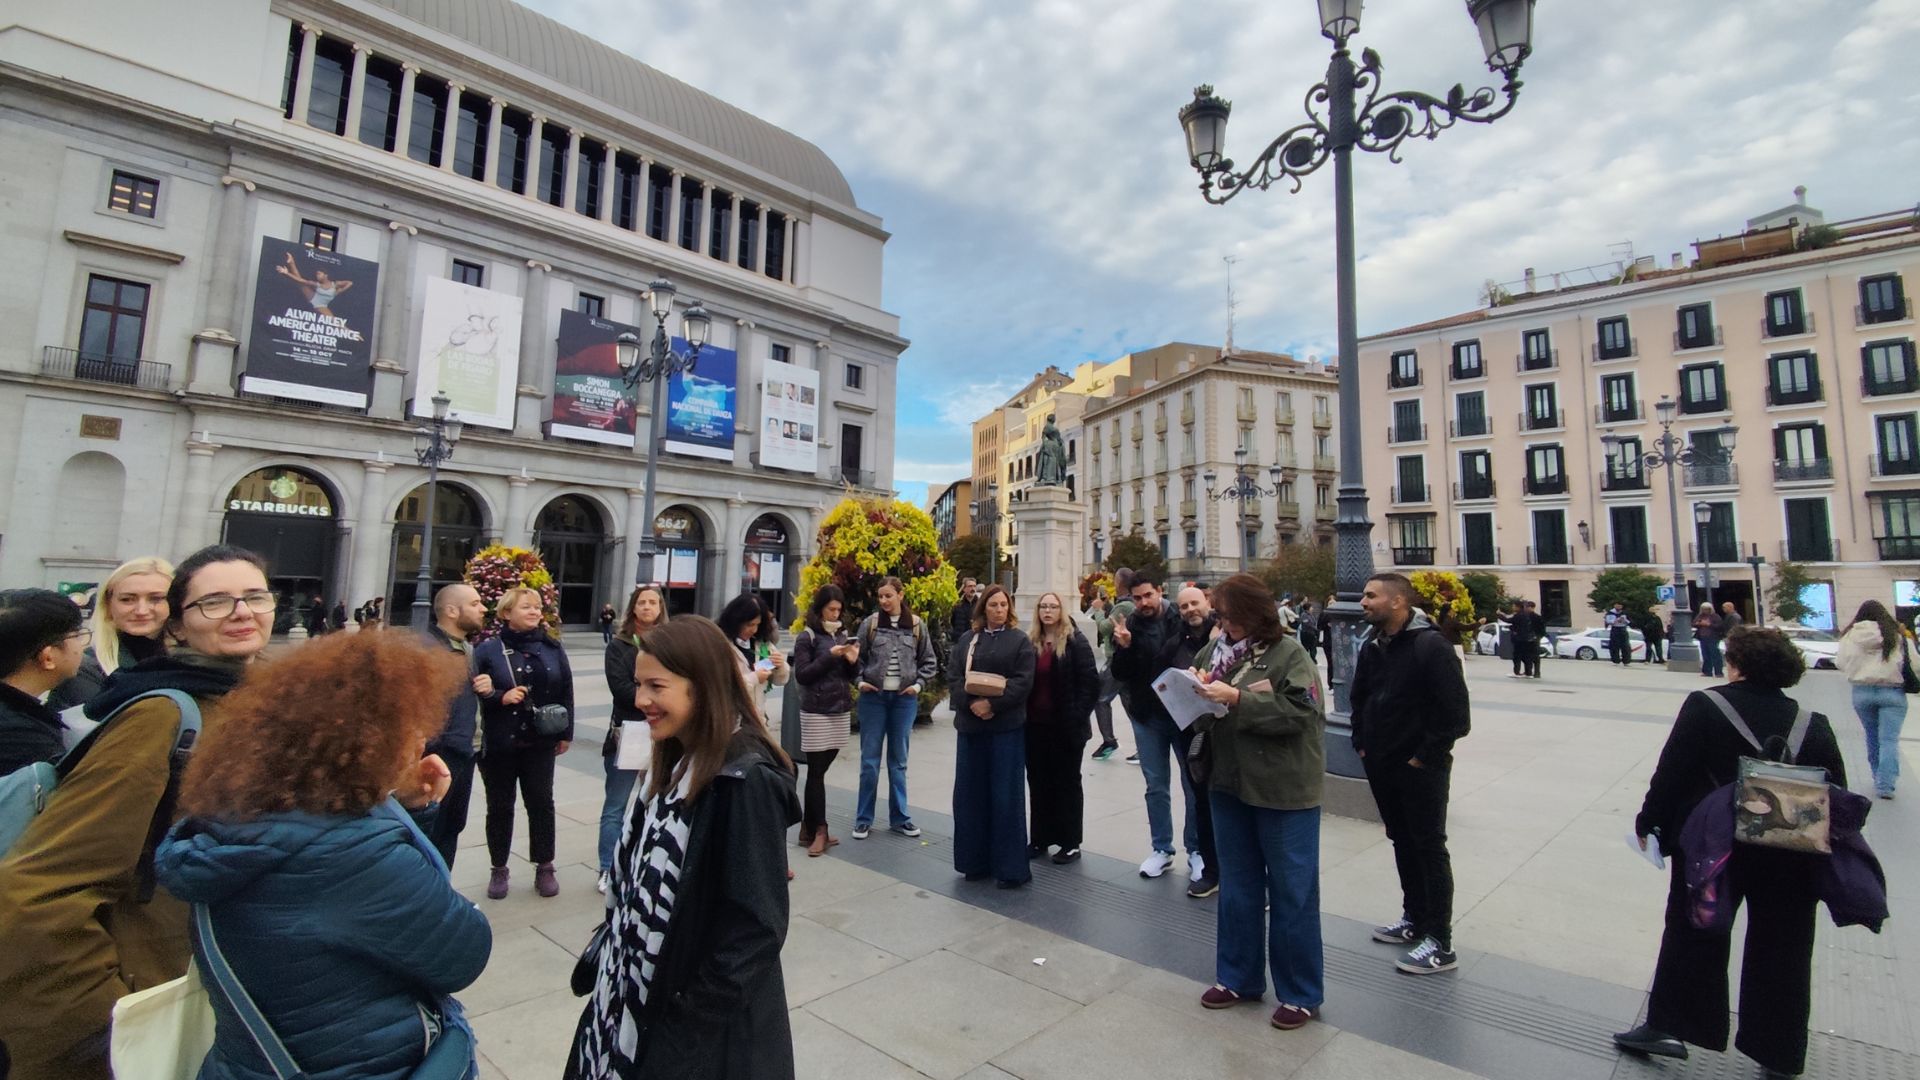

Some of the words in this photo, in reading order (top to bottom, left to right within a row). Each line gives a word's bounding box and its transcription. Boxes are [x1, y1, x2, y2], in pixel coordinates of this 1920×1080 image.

[285, 308, 317, 323] ALVIN
[317, 314, 348, 328] AILEY
[268, 315, 325, 334] AMERICAN
[325, 326, 361, 341] DANCE
[292, 330, 338, 347] THEATER
[573, 383, 622, 399] BOCCANEGRA
[230, 499, 329, 516] STARBUCKS
[1660, 588, 1670, 599] P
